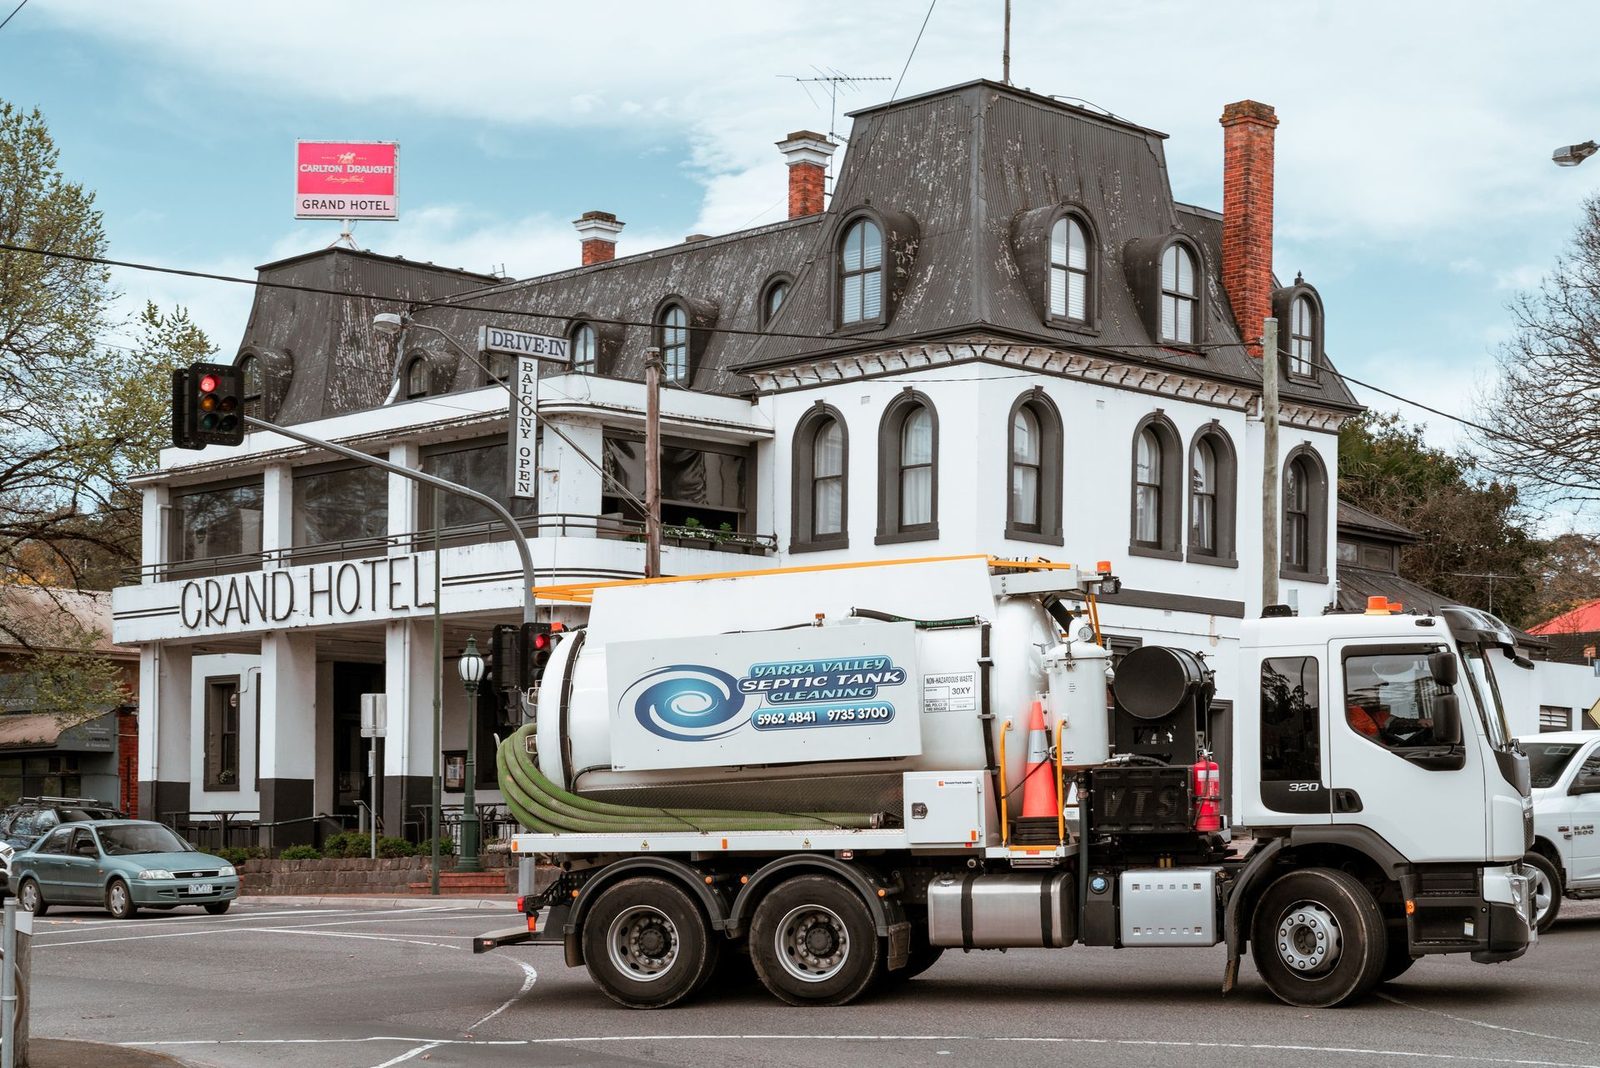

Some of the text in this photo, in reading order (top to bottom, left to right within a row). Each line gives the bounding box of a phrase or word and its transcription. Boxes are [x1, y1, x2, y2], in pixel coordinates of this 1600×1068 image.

[299, 164, 393, 174] CARLTON DRAUGHT
[302, 199, 390, 211] GRAND HOTEL
[519, 361, 534, 439] BALCONY
[518, 446, 531, 493] OPEN
[181, 554, 436, 629] GRAND HOTEL
[754, 659, 886, 677] YARRA VALLEY
[742, 671, 901, 691] SEPTIC TANK
[769, 687, 873, 701] CLEANING
[952, 687, 971, 695] 30XY
[757, 706, 888, 725] 5962 4841 9735 3700
[1288, 782, 1319, 792] 320
[1103, 785, 1179, 817] VTS
